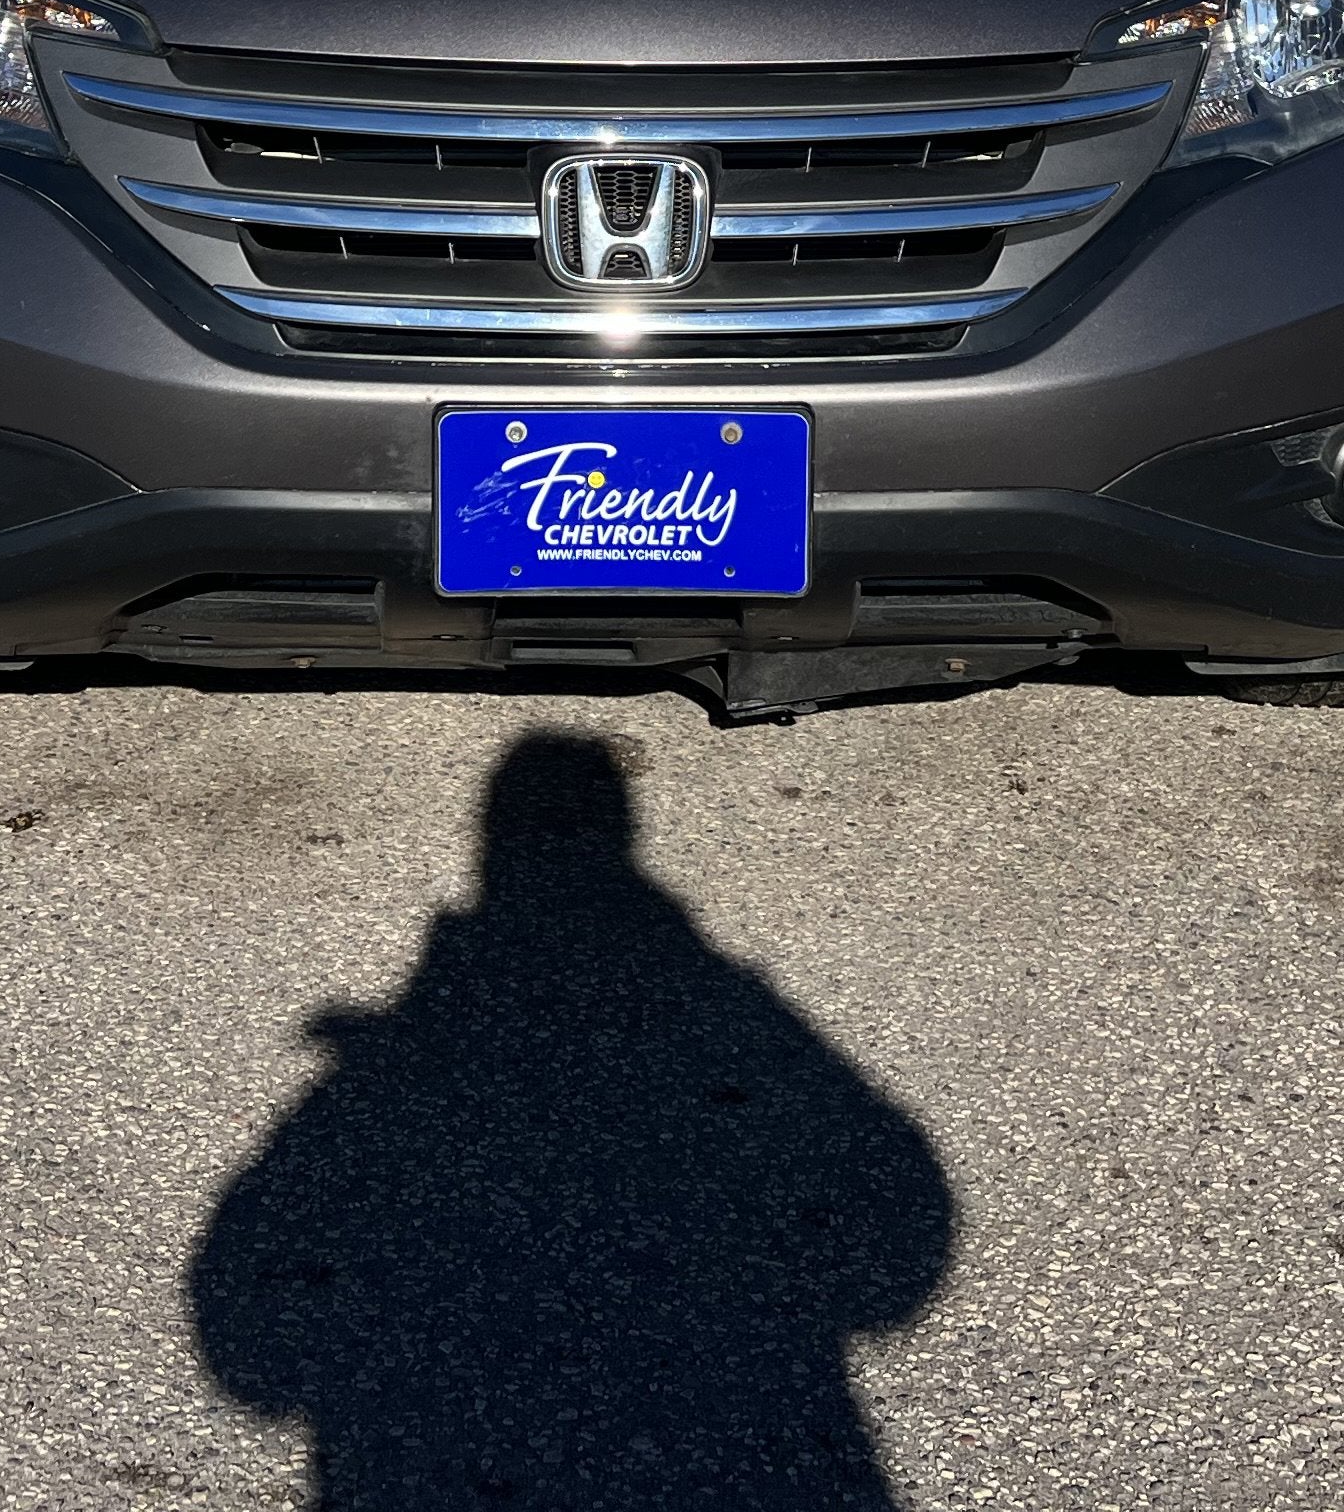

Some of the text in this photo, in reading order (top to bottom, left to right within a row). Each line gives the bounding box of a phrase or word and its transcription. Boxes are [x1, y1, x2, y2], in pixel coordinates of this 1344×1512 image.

[500, 442, 737, 546] Friendly
[544, 524, 693, 546] CHEVROLET
[536, 548, 703, 562] WWW.FRIENDLYCHEV.COM
